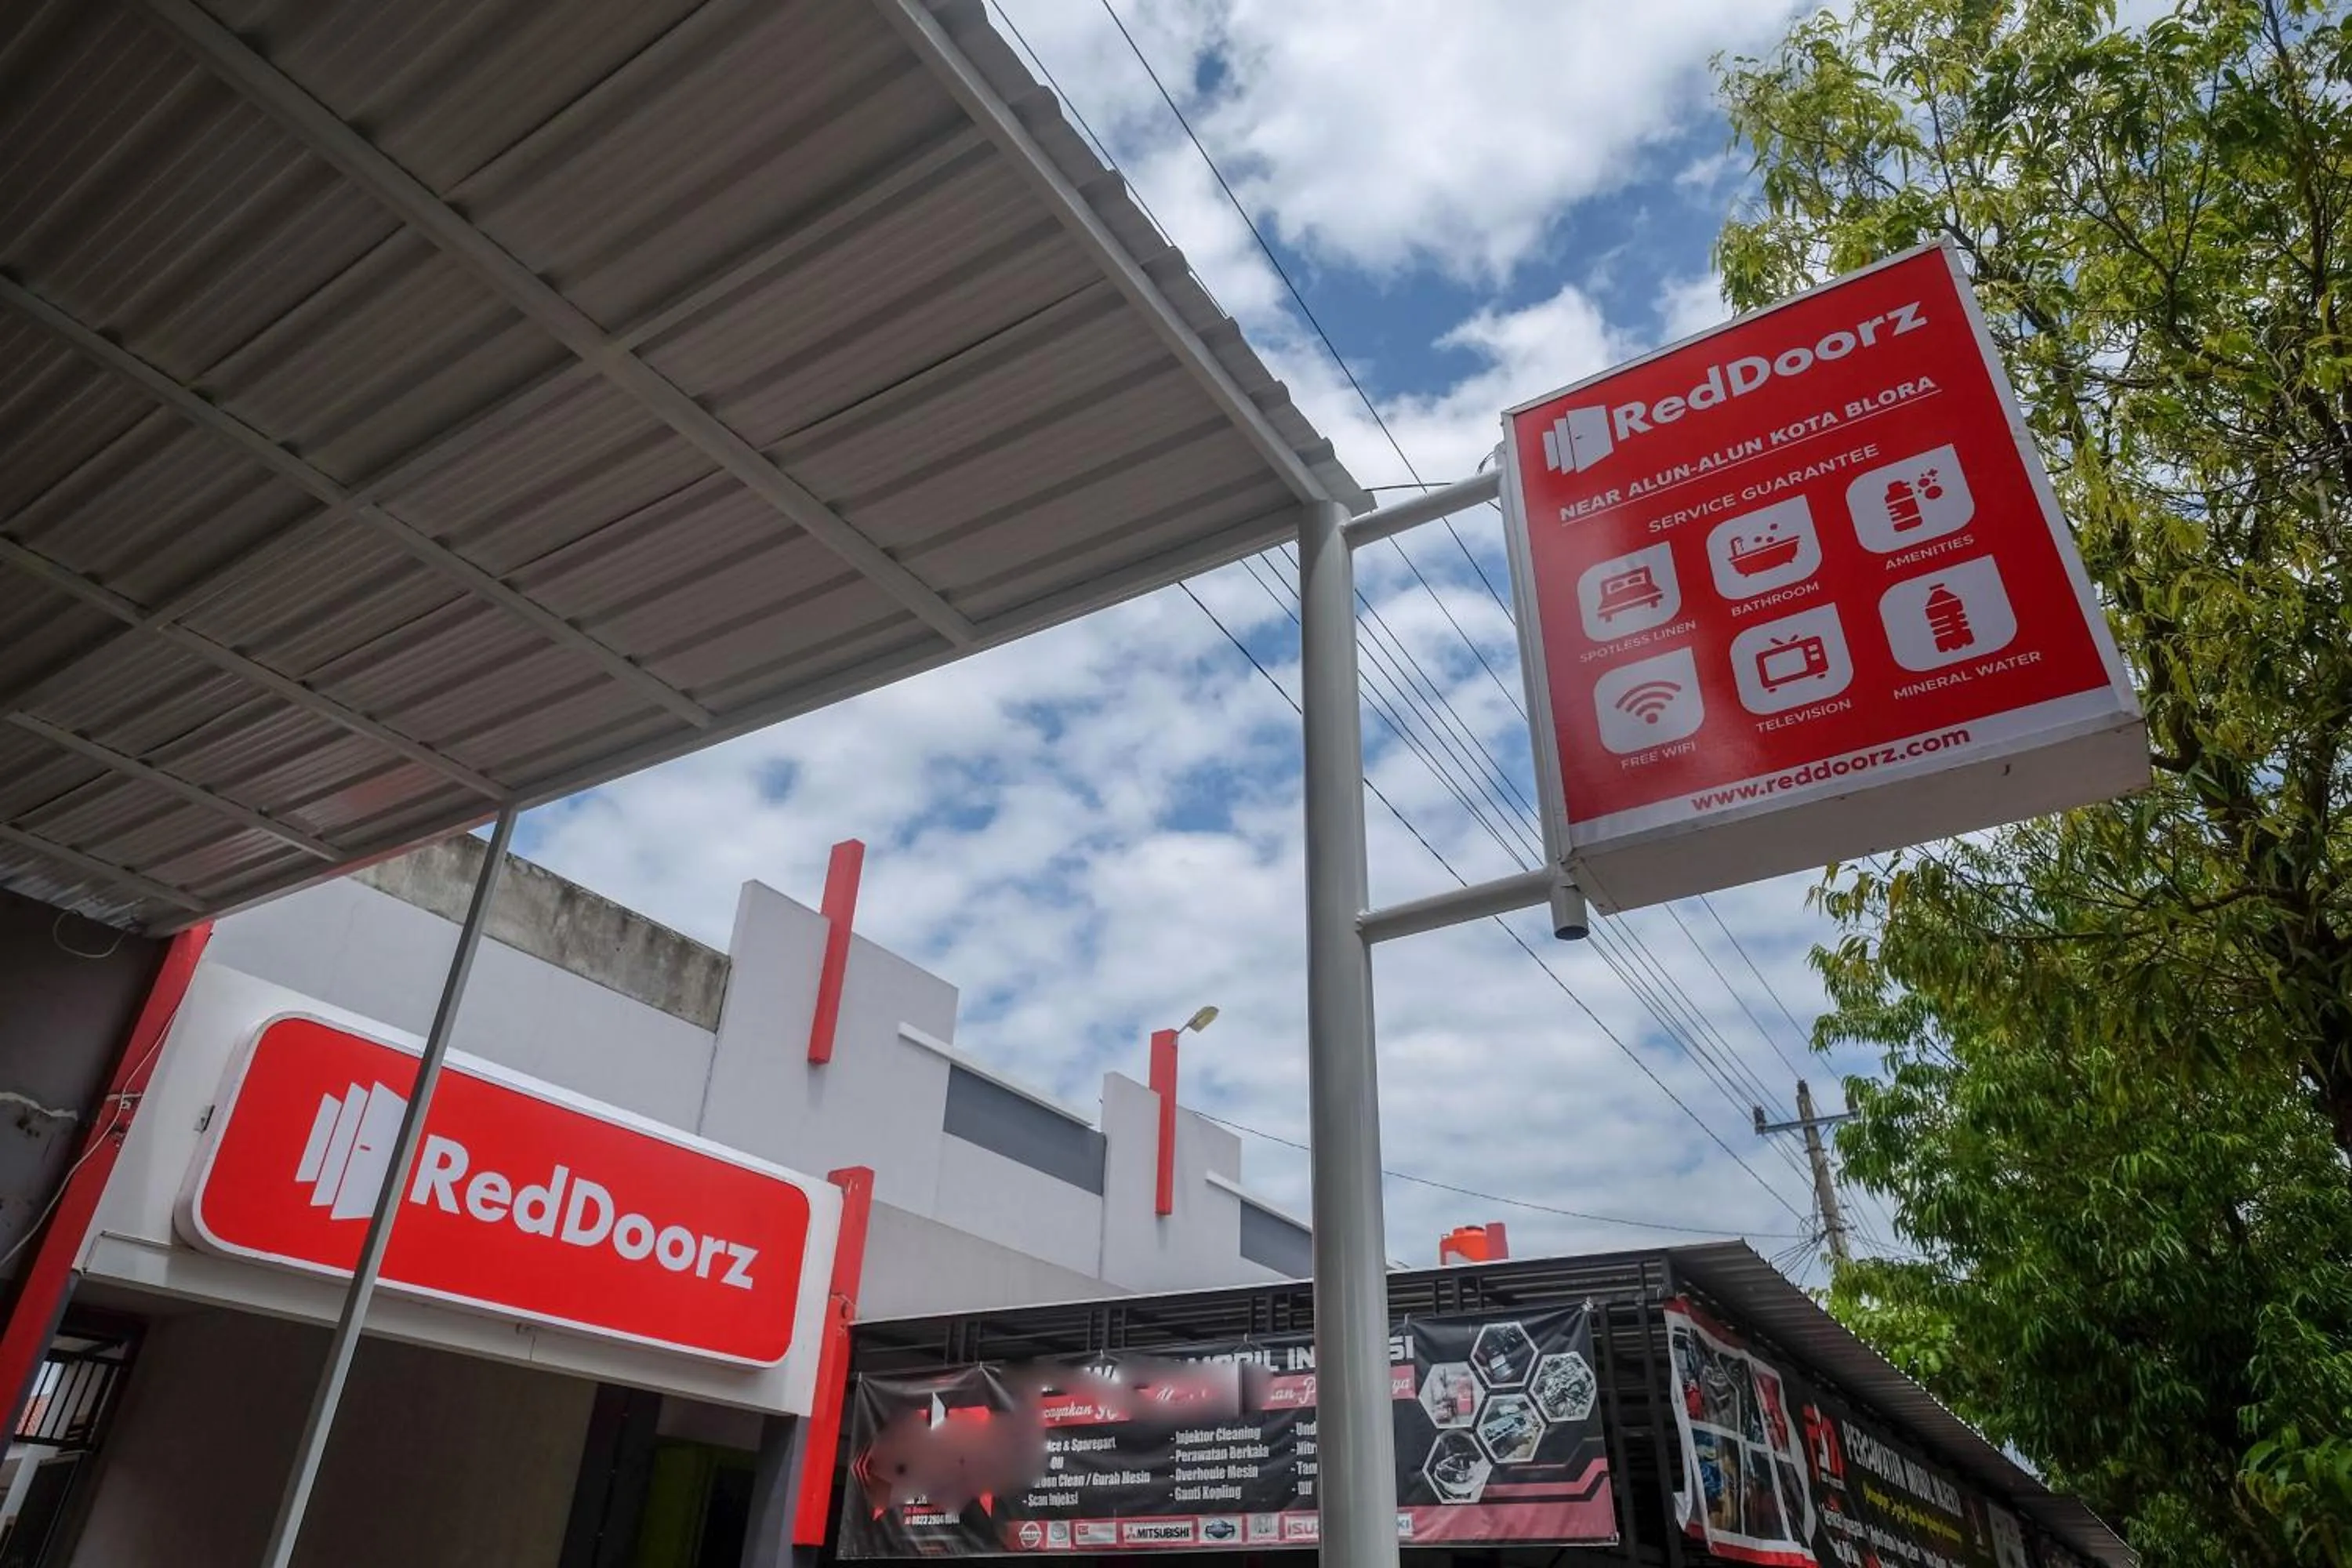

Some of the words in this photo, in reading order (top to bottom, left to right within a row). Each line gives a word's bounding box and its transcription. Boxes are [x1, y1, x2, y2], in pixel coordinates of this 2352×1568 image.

[1612, 300, 1929, 442] RedDoorz
[1560, 488, 1622, 522] NEAR
[1628, 436, 1763, 499] ALUN-ALUN
[1769, 410, 1839, 445] KOTA
[1844, 376, 1937, 419] BLORA
[1648, 492, 1737, 533] SERVICE
[1740, 442, 1880, 501] GUARANTEE
[1884, 533, 1976, 572] AMENITIES
[1730, 581, 1820, 618] BATHROOM
[1578, 633, 1650, 664] SPOTLESS
[1653, 619, 1697, 641] LINEN
[1893, 668, 1974, 701] MINERAL
[1974, 650, 2042, 678] WATER
[1755, 698, 1852, 734] TELEVISION
[1621, 749, 1658, 770] FREE
[1661, 741, 1697, 760] WIFI
[1690, 728, 1970, 812] www.reddoorz.com
[408, 1134, 760, 1290] RedDoorz
[1215, 1425, 1262, 1442] Cleaning
[1175, 1448, 1229, 1463] Perawatan
[1227, 1464, 1258, 1479] Mesin
[1136, 1526, 1189, 1540] MITSUBISHI
[1287, 1522, 1319, 1537] ISU
